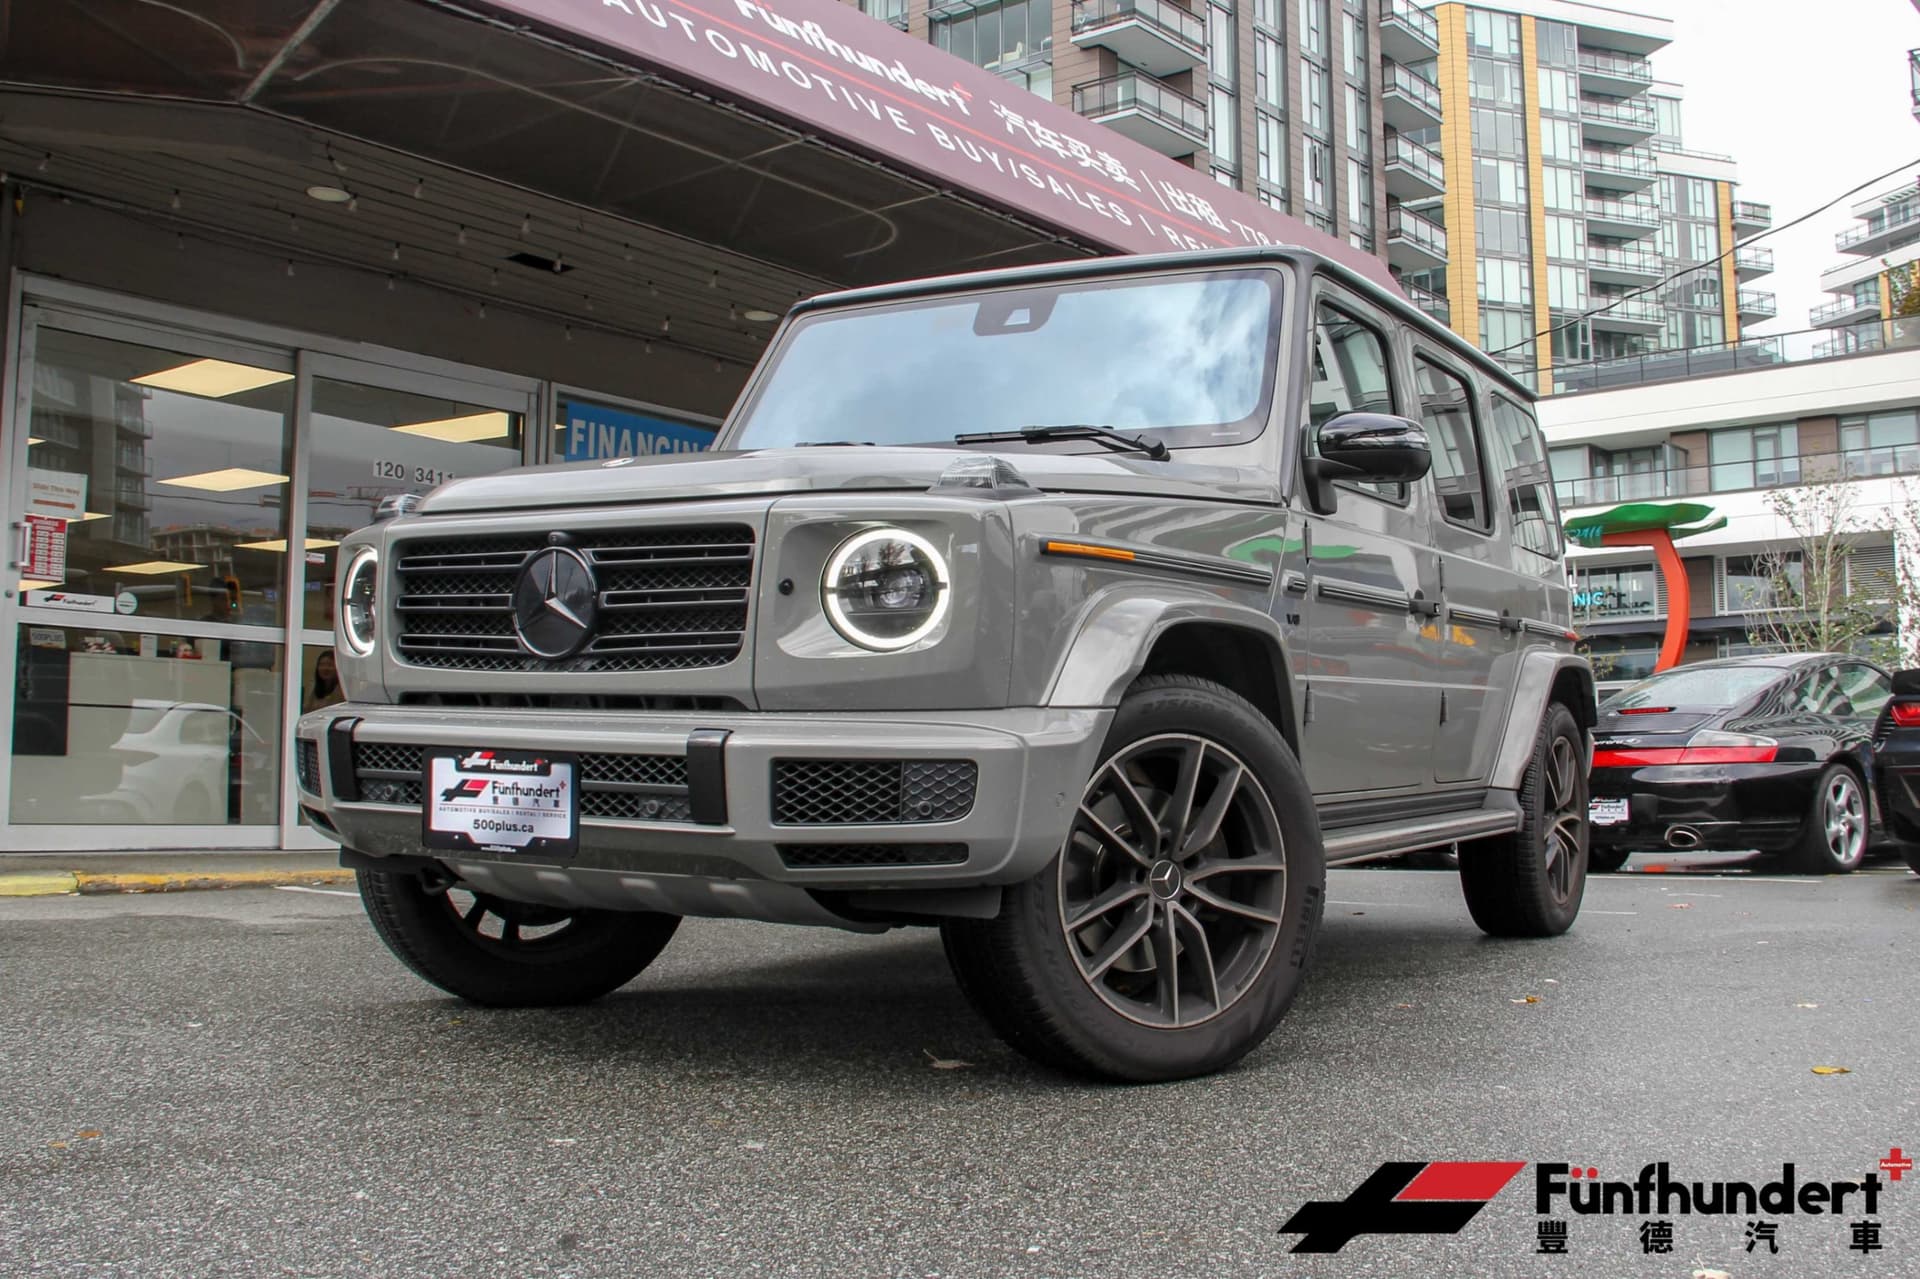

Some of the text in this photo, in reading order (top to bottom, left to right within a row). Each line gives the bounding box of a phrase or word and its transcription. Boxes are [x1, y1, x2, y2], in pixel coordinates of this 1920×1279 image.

[989, 99, 1142, 193] 汽车买卖
[1158, 180, 1232, 234] 出租
[570, 418, 713, 459] FINANC
[375, 460, 405, 480] 120
[473, 819, 535, 833] 500plus.ca
